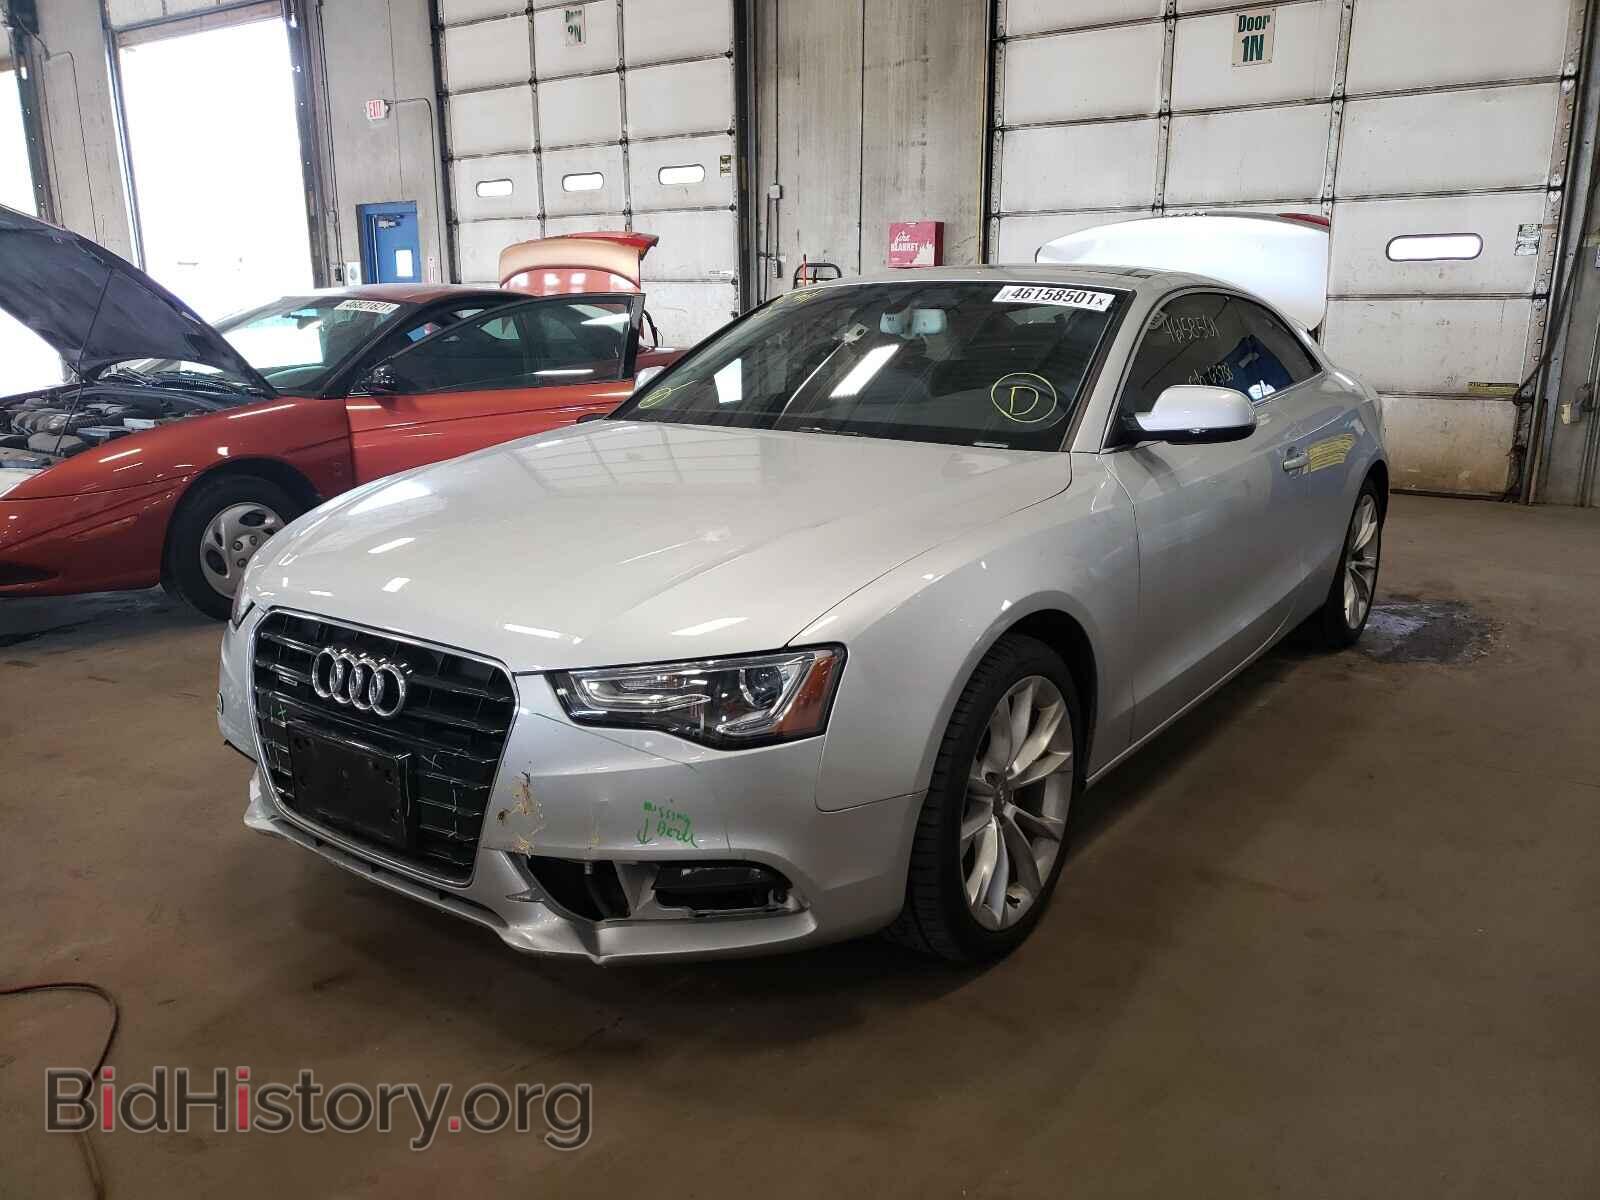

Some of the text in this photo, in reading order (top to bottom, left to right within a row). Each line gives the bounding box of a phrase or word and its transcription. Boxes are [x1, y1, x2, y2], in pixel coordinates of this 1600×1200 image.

[1238, 14, 1270, 33] Door
[1242, 34, 1264, 62] 1N
[1011, 287, 1096, 305] 46158501
[1009, 386, 1039, 416] D
